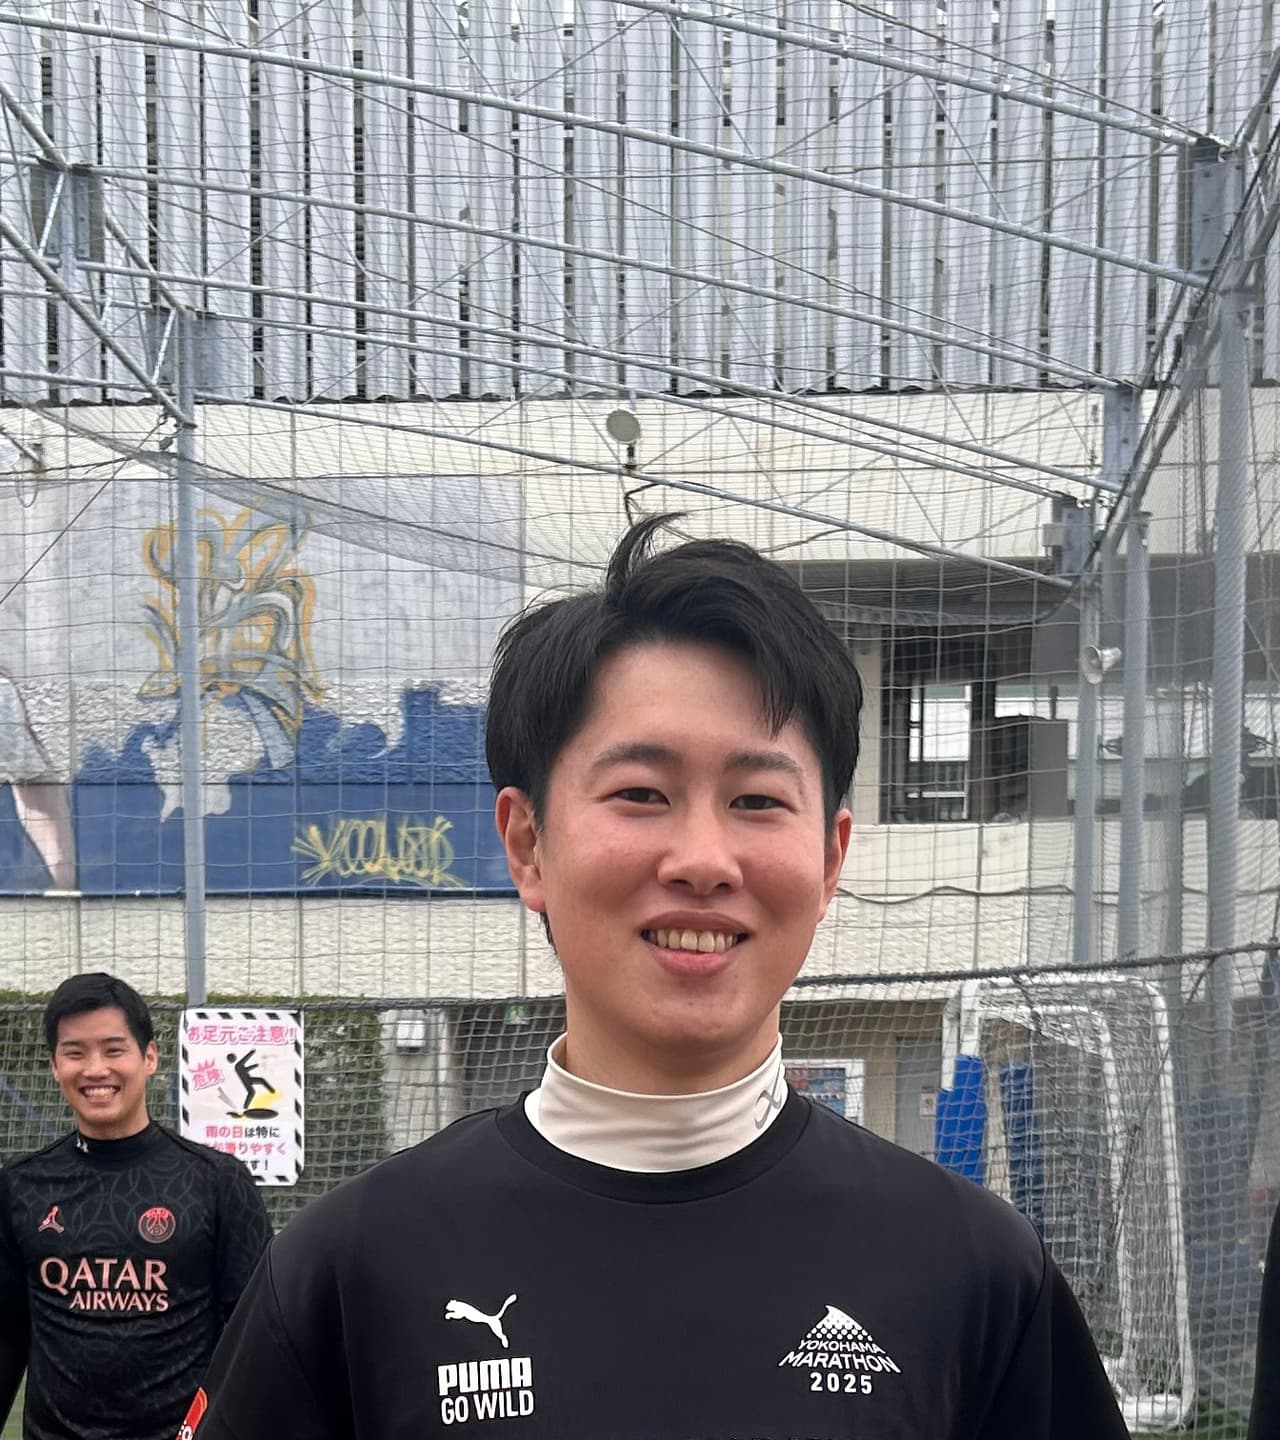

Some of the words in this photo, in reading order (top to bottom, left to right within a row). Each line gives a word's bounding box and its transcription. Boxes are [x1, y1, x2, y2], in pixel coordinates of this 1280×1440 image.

[206, 1126, 281, 1139] 雨の日は特に
[204, 1141, 287, 1155] が滑りやすく
[40, 1256, 169, 1296] QATAR
[69, 1290, 169, 1312] AIRWAYS
[798, 1339, 886, 1354] YOKOHAMA
[778, 1351, 902, 1374] MARATHON
[437, 1356, 533, 1396] PUMA
[810, 1371, 873, 1395] 2025
[441, 1395, 469, 1425] GO
[473, 1389, 535, 1420] WILD
